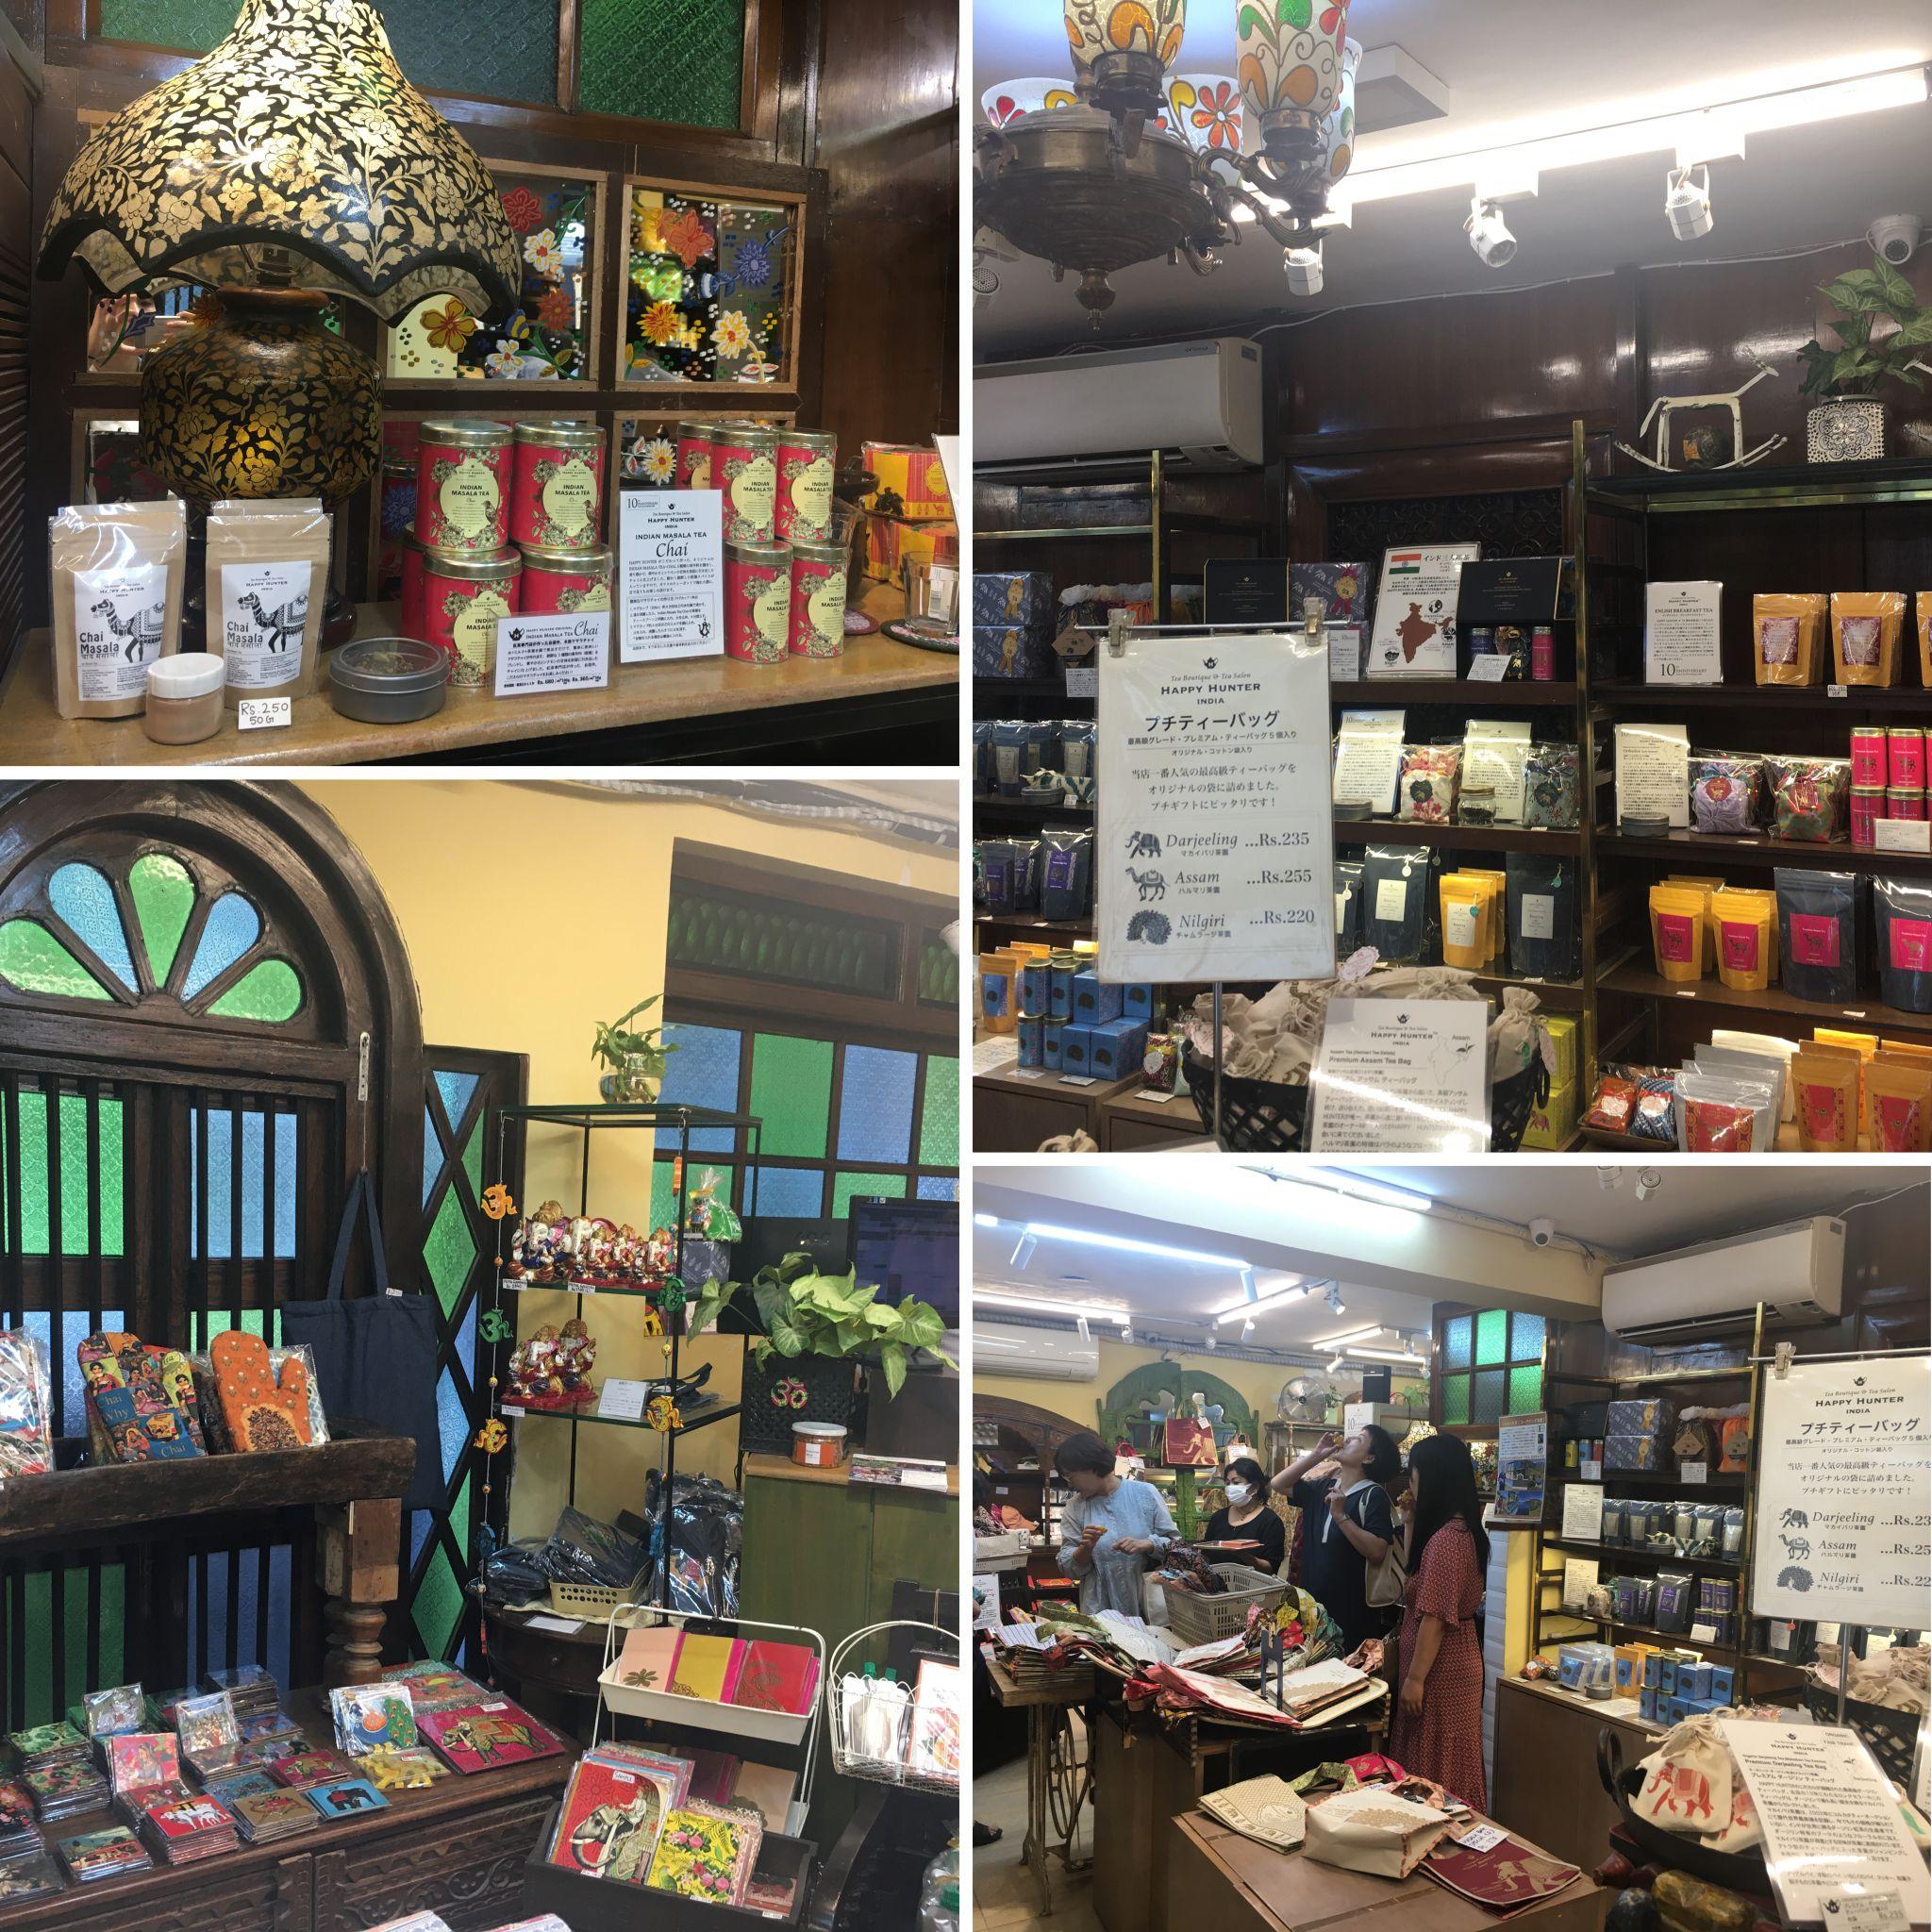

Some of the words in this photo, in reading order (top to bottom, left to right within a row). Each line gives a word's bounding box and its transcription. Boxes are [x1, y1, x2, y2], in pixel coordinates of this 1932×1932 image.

[627, 497, 638, 508] 10
[656, 539, 689, 558] Chai
[226, 621, 249, 633] Chai
[575, 620, 599, 637] Chai
[80, 631, 104, 642] Chai
[226, 632, 263, 644] Masala
[80, 642, 119, 655] Masala
[1660, 663, 1675, 676] 10
[1160, 685, 1203, 695] HAPPY
[1208, 683, 1261, 693] HUNTER
[1145, 710, 1280, 732] プチティーバッグ
[1132, 763, 1297, 780] 当店一番人気の最高級ティーバッグを
[1148, 781, 1280, 794] オリジナルの袋に詰めました。
[1166, 832, 1238, 849] Darjeeling
[1180, 848, 1229, 858] マカイバリ茶園
[1174, 871, 1220, 884] Assam
[1178, 886, 1221, 894] ハルマリ茶園
[1179, 913, 1225, 932] Nilgiri
[1857, 1396, 1904, 1405] HUNTER
[1801, 1417, 1921, 1435] プチティーバッグ
[160, 1443, 188, 1457] Chai
[1812, 1511, 1874, 1524] Darjeeling
[1818, 1540, 1857, 1551] Assam
[1820, 1572, 1860, 1586] Nilgiri
[1773, 1760, 1803, 1769] Darjeeling
[615, 1772, 634, 1782] SAMPLE
